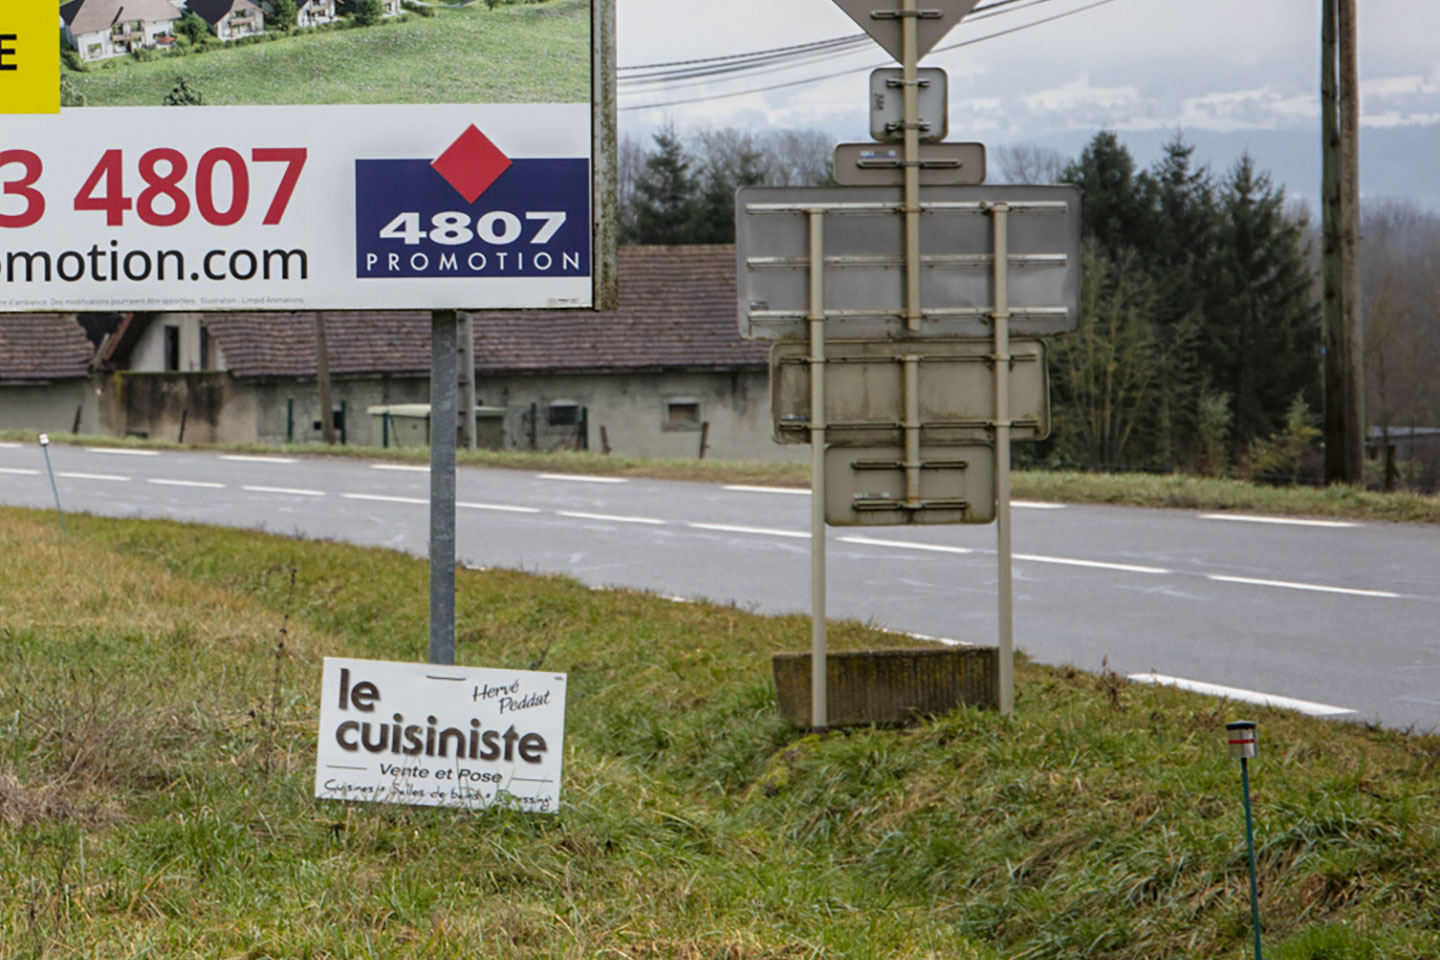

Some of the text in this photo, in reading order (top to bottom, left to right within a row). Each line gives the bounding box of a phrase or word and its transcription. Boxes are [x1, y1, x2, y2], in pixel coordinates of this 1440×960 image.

[73, 147, 307, 227] 4807
[379, 210, 567, 246] 4807
[366, 251, 579, 271] PROMOTION
[337, 667, 381, 713] le
[472, 679, 520, 702] Hervé
[335, 712, 548, 764] cuisiniste
[379, 763, 503, 784] Vente et Pose
